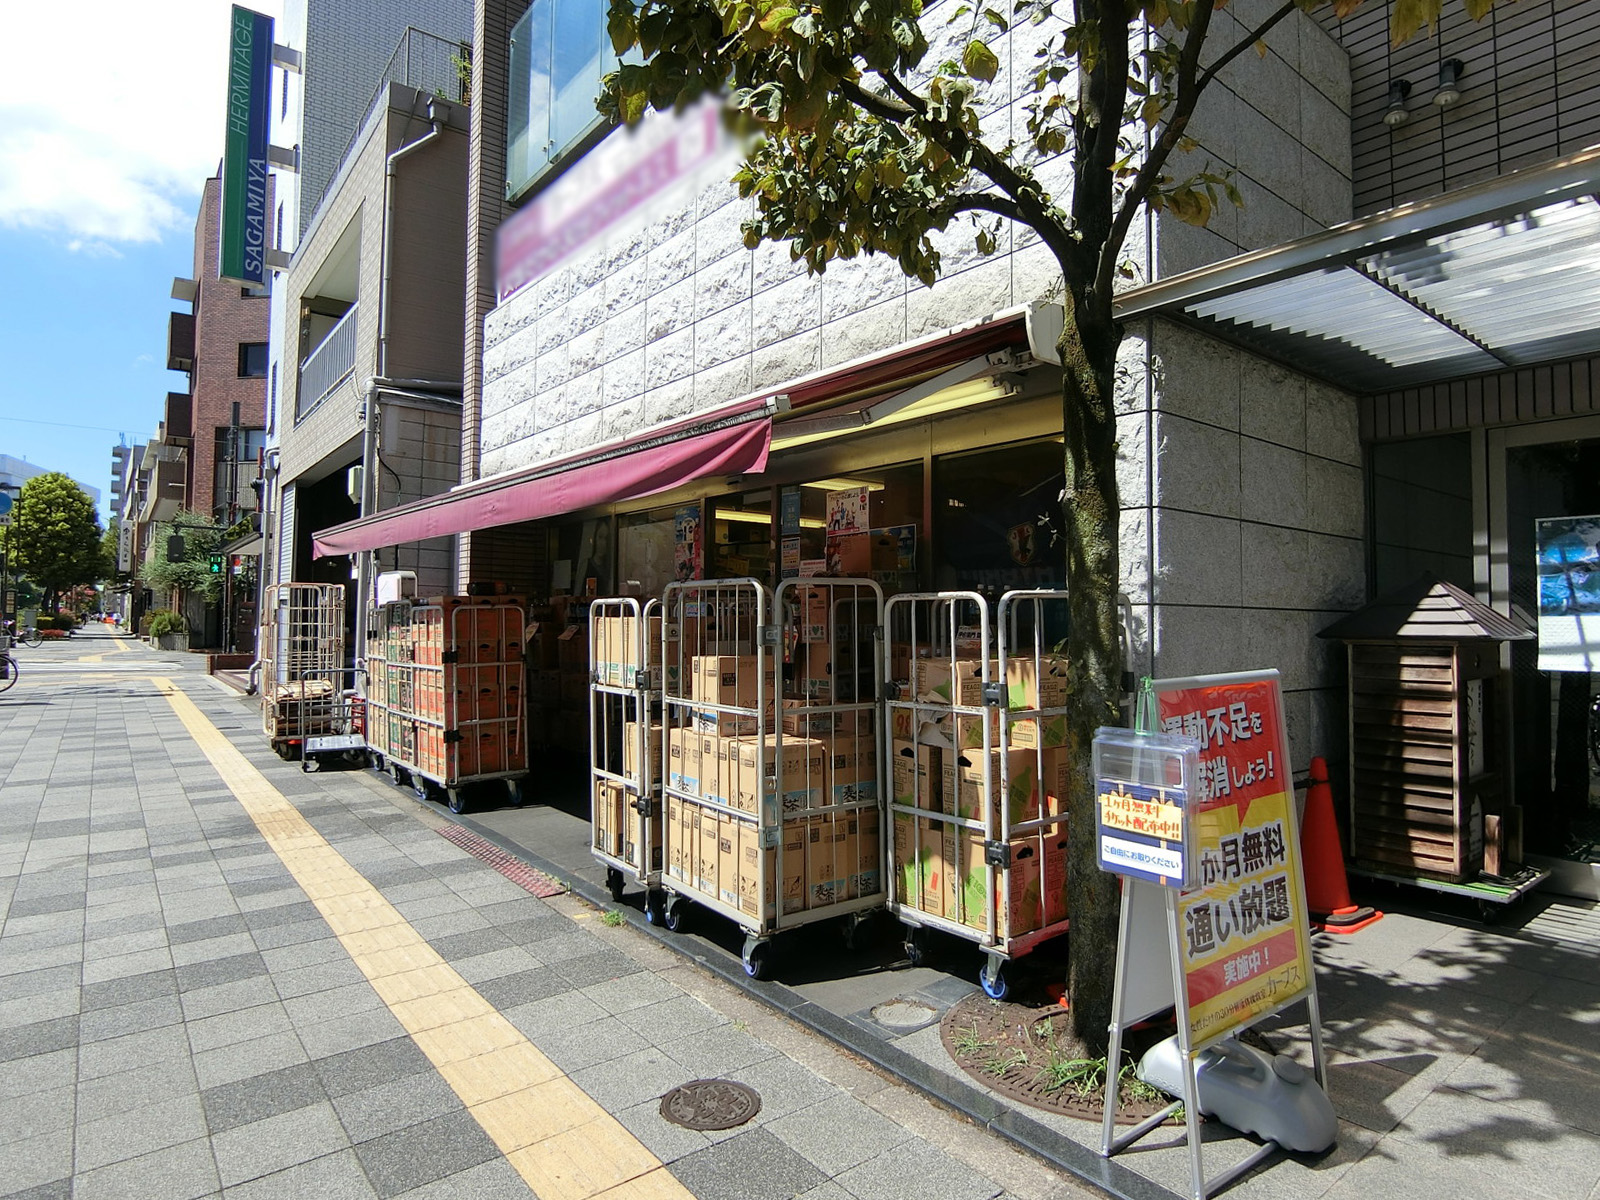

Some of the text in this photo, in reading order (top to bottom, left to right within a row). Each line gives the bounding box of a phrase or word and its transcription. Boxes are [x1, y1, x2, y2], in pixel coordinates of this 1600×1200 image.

[230, 15, 253, 137] HERMITAGE
[244, 157, 267, 276] SAGAMIYA
[1104, 845, 1180, 869] ご自由にお取りください
[1201, 823, 1285, 886] か月無料
[815, 884, 835, 902] 麦茶
[1186, 878, 1290, 958] 通い放題
[1266, 965, 1301, 997] カーブス
